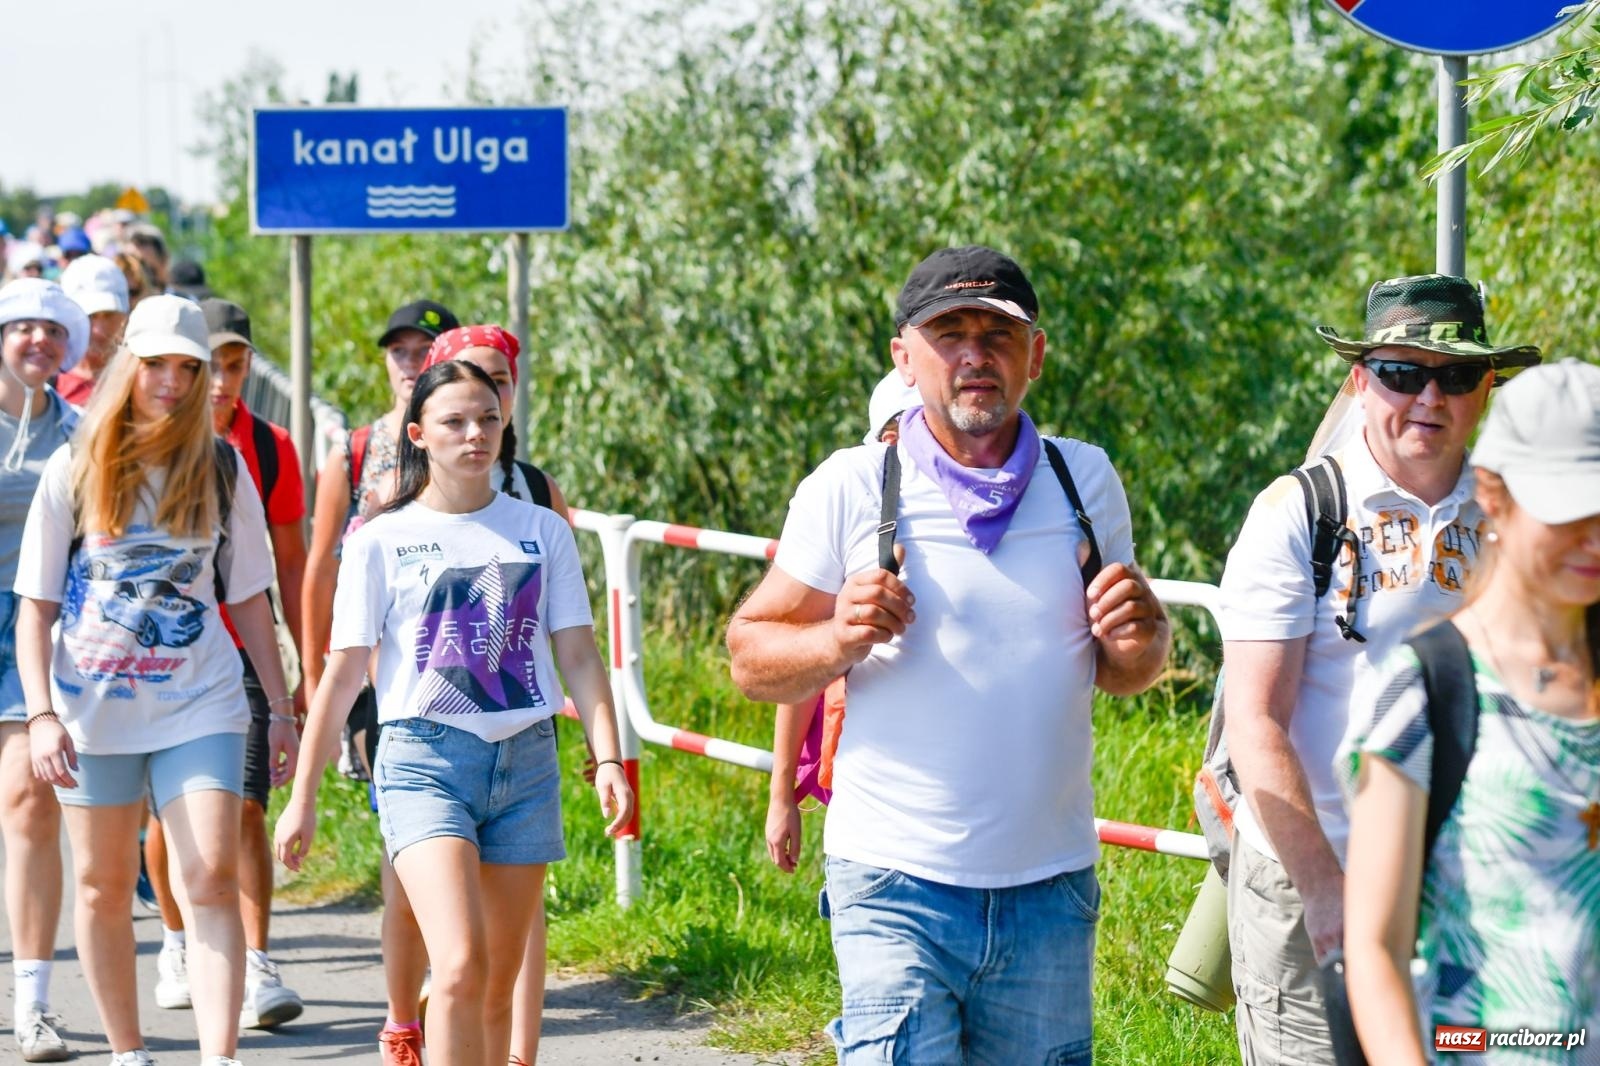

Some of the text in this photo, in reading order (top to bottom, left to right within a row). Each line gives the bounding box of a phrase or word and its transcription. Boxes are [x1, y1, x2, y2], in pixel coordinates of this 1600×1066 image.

[293, 126, 528, 174] kanał Ulga
[985, 490, 1004, 509] 5
[396, 542, 442, 557] BORA
[415, 618, 539, 638] PETER
[415, 635, 533, 662] SAGAN
